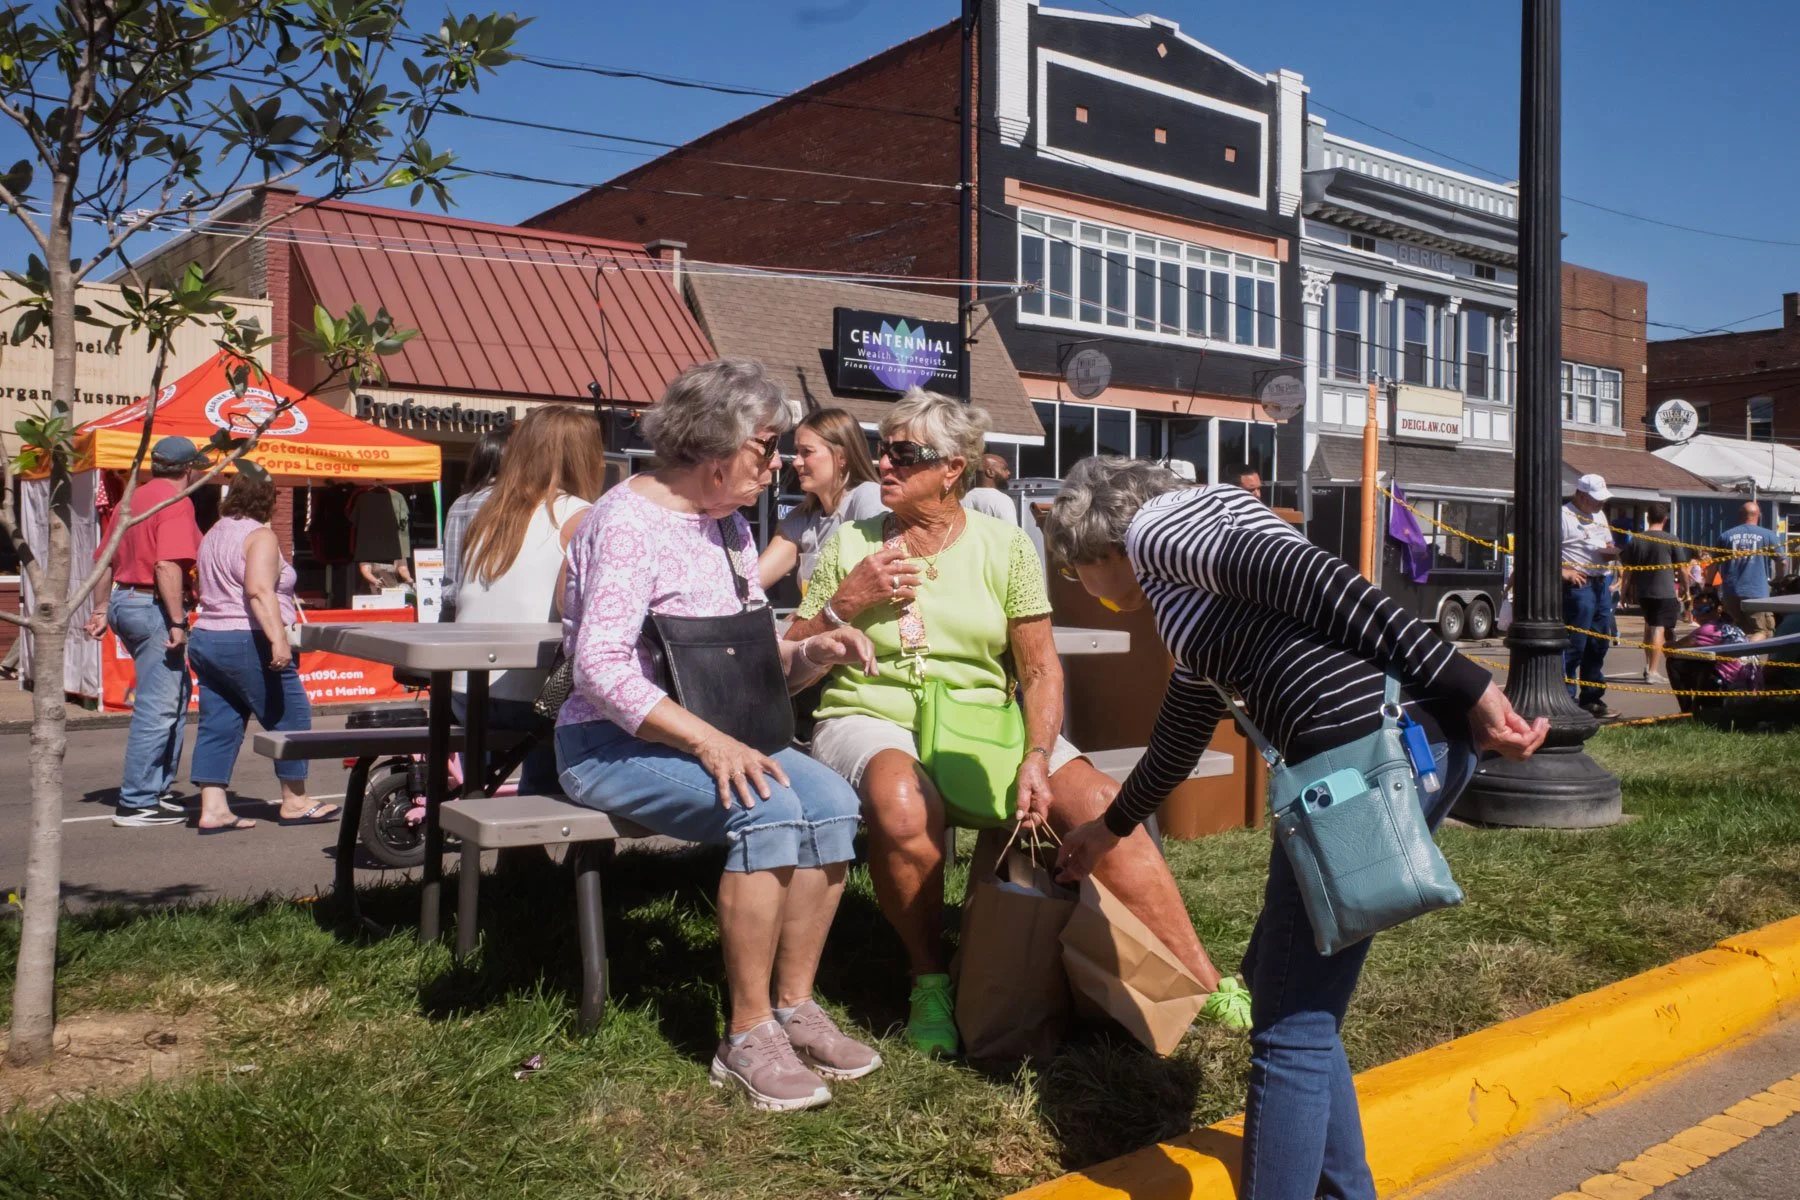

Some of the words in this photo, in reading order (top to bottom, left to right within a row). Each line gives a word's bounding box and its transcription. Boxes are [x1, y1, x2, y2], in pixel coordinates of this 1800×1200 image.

[850, 329, 953, 354] CENTENNIAL
[857, 347, 891, 360] Wealth
[895, 353, 947, 367] Strategists
[844, 361, 884, 372] Financial
[888, 366, 916, 375] Dreams
[920, 369, 957, 379] Delivered
[356, 394, 516, 428] Professional
[1402, 418, 1459, 435] DEIGLAW.COM
[259, 440, 354, 459] Detachment
[357, 449, 390, 460] 1090
[256, 456, 300, 473] Corps
[305, 458, 360, 474] League
[325, 688, 333, 696] a
[335, 685, 376, 696] Marine
